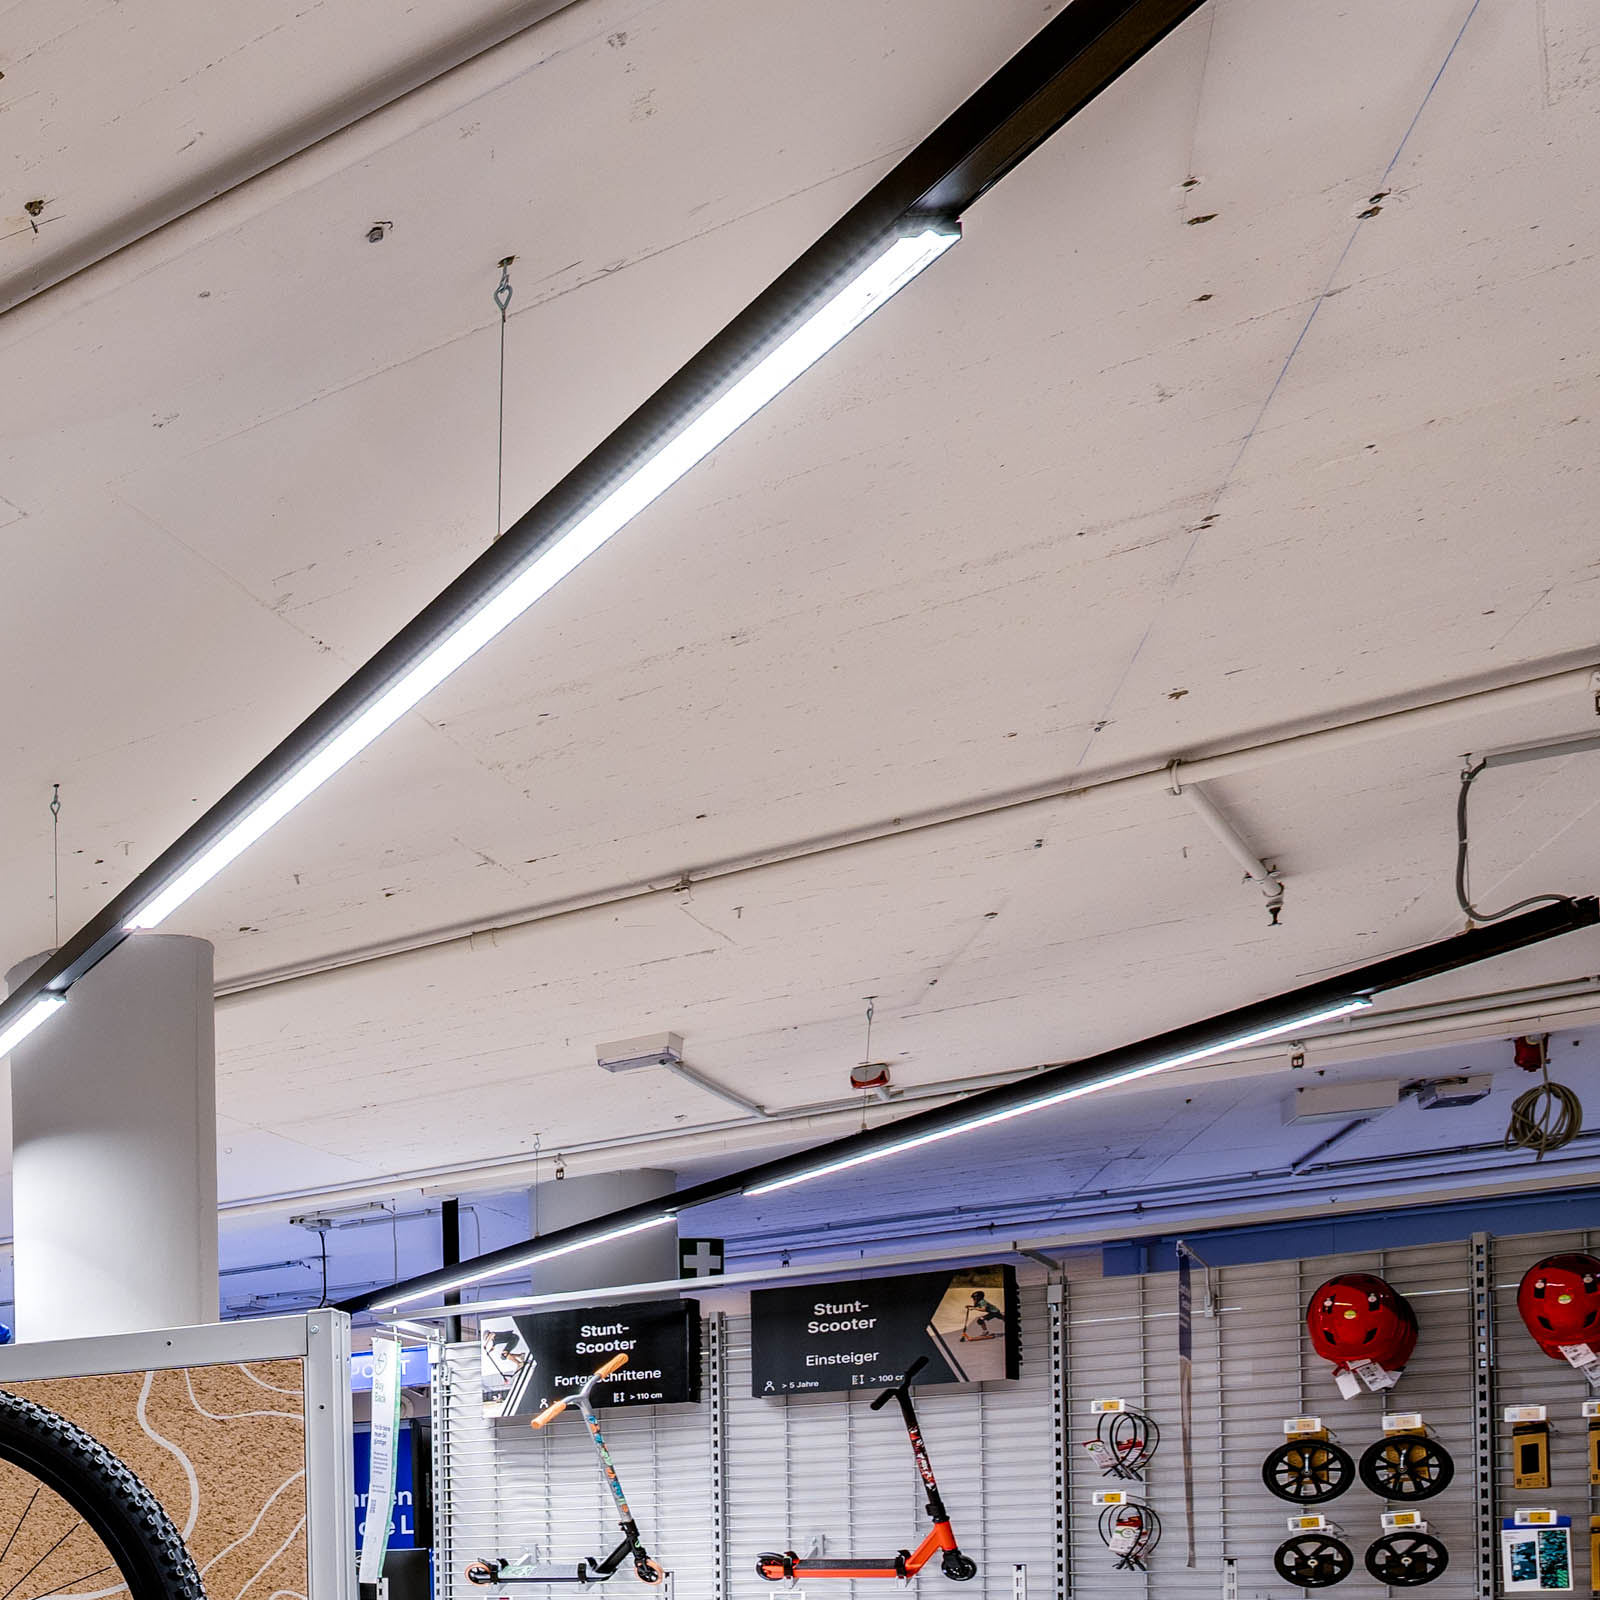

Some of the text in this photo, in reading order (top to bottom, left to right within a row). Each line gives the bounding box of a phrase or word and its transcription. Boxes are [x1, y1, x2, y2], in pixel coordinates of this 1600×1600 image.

[813, 1300, 869, 1316] Stunt-
[580, 1323, 630, 1338] Stunt-
[807, 1317, 877, 1334] Scooter
[575, 1338, 637, 1355] Scooter
[805, 1351, 880, 1368] Einsteiger
[554, 1369, 662, 1388] Fortgchrittene
[796, 1380, 819, 1388] Jahre
[878, 1374, 894, 1383] 100
[636, 1392, 650, 1400] 110
